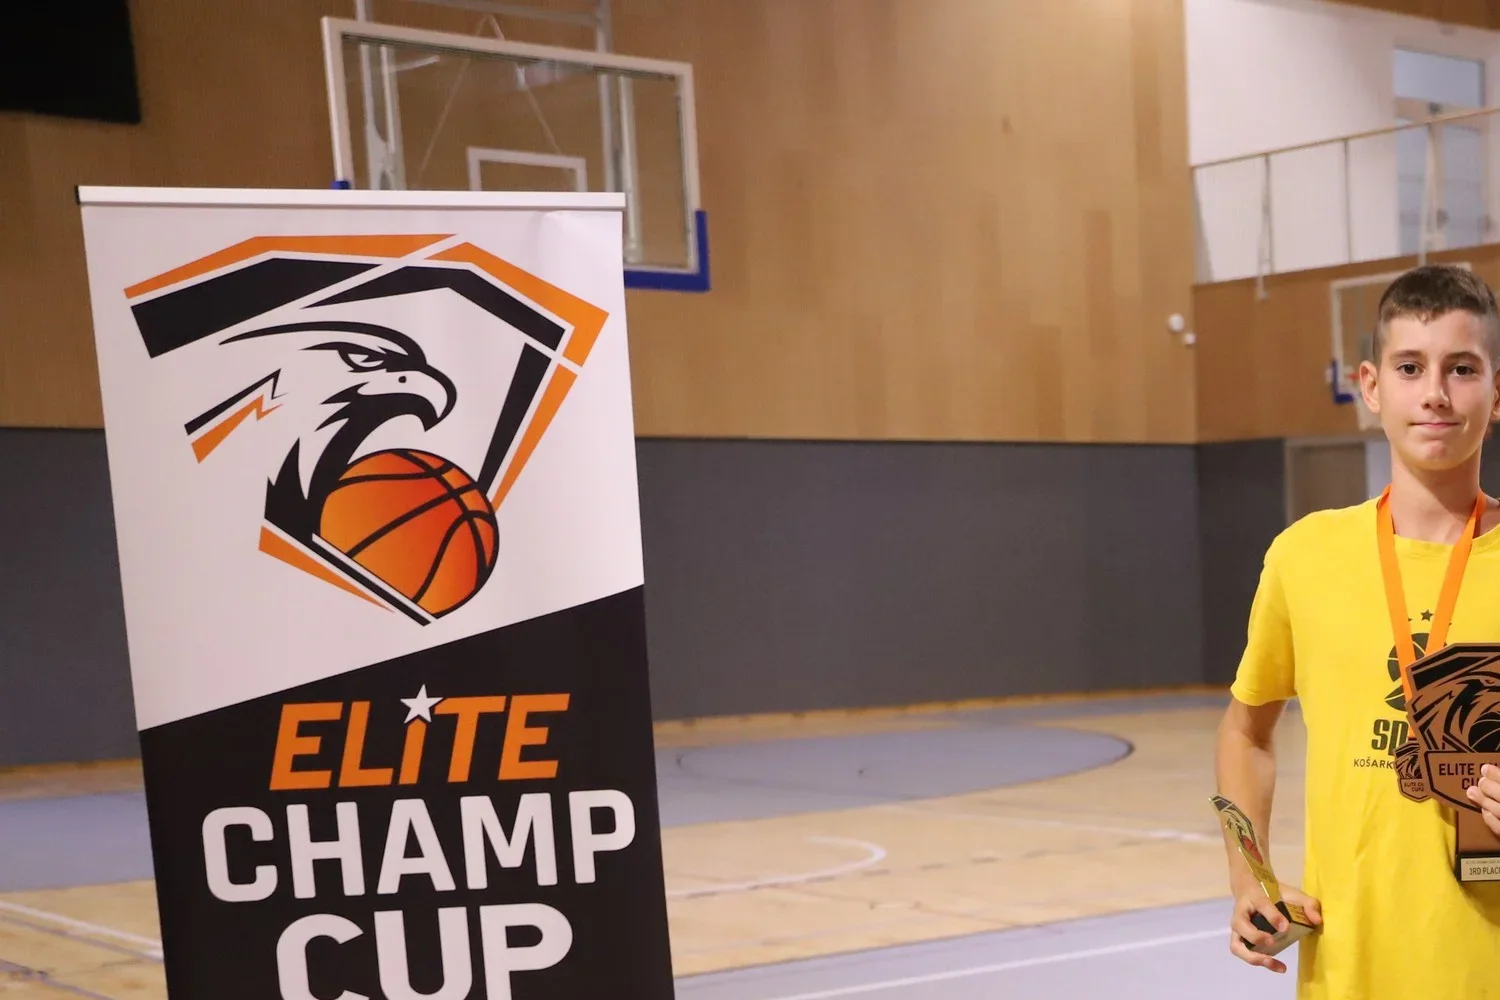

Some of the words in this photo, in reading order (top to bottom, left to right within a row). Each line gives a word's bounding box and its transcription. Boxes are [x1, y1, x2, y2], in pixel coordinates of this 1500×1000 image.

[1353, 756, 1395, 770] KOŠARK
[1438, 762, 1475, 776] ELITE
[202, 788, 636, 904] CHAMP
[1469, 867, 1482, 876] 3RD
